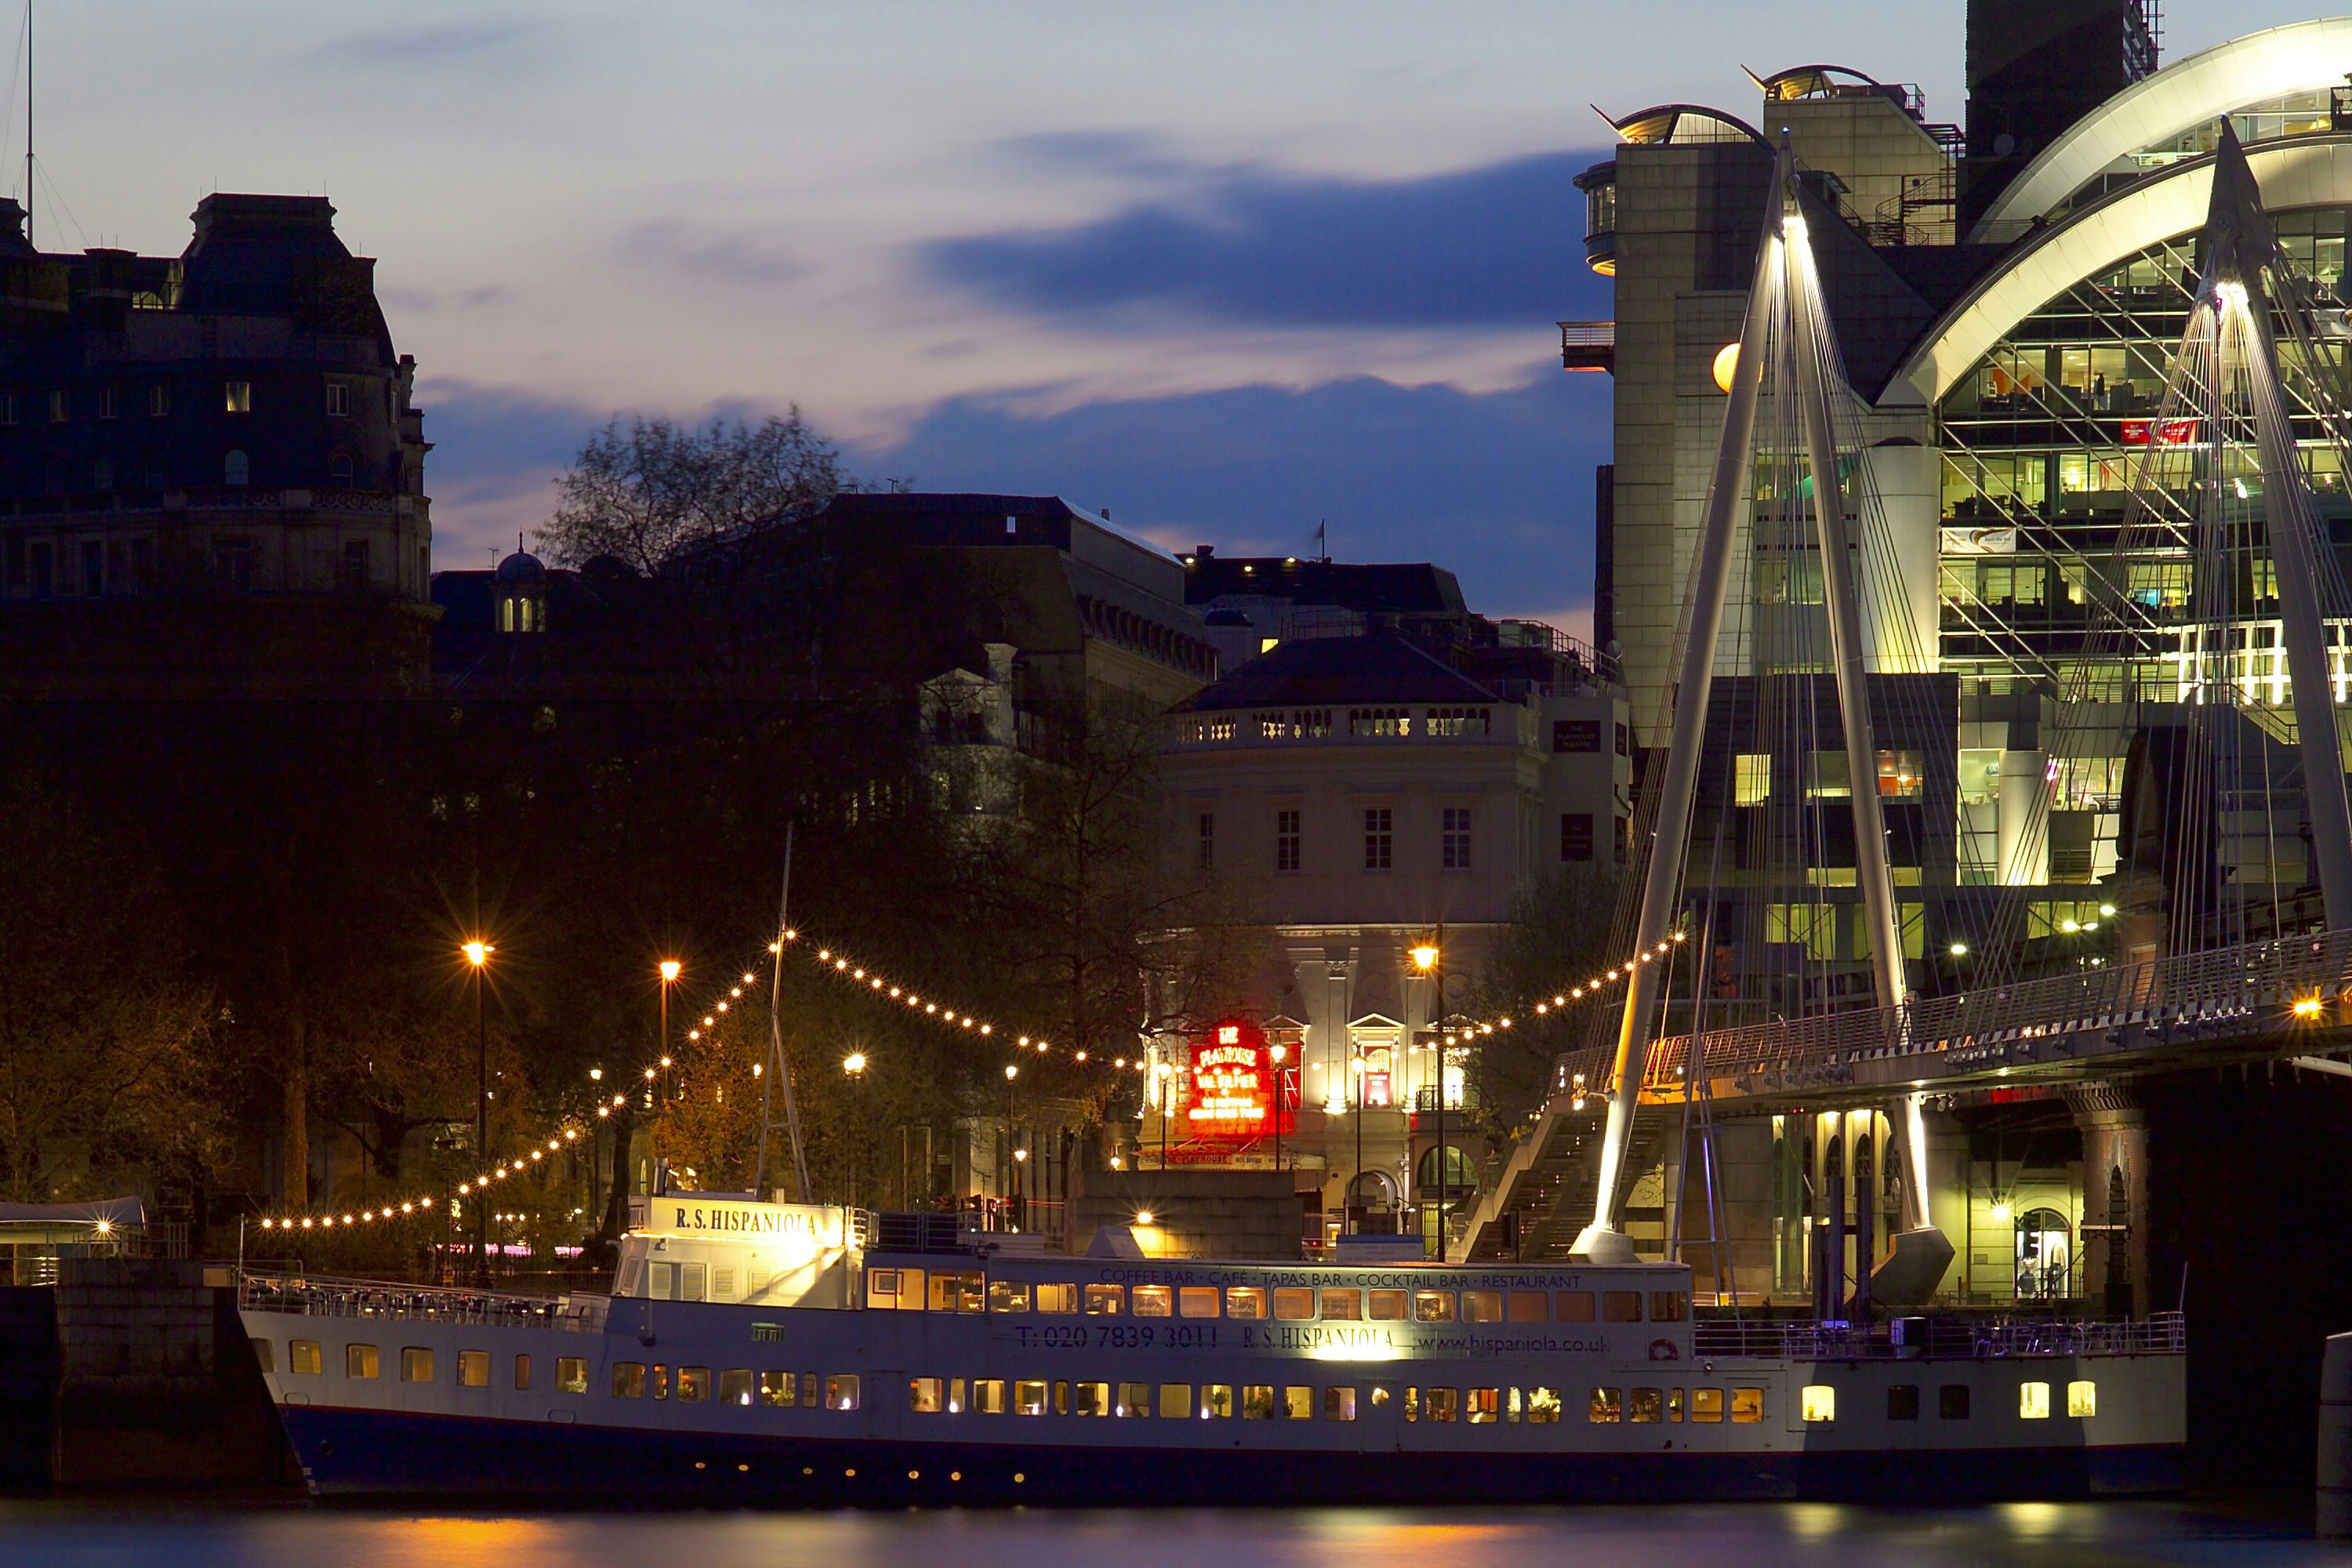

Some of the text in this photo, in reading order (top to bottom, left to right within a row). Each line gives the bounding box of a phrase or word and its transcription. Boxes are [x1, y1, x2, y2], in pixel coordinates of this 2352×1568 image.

[1218, 1026, 1239, 1044] THE
[1200, 1047, 1256, 1067] PLAYHOUSE
[1101, 1269, 1581, 1288] COFFEE BAR CAFÉ TAPAS BAR COCKTAIL BAR RESTAURANT
[1044, 1326, 1087, 1348] 020
[1097, 1326, 1155, 1348] 7839
[1165, 1327, 1217, 1348] 3011
[1417, 1334, 1607, 1356] www.hispaniola.co.uk
